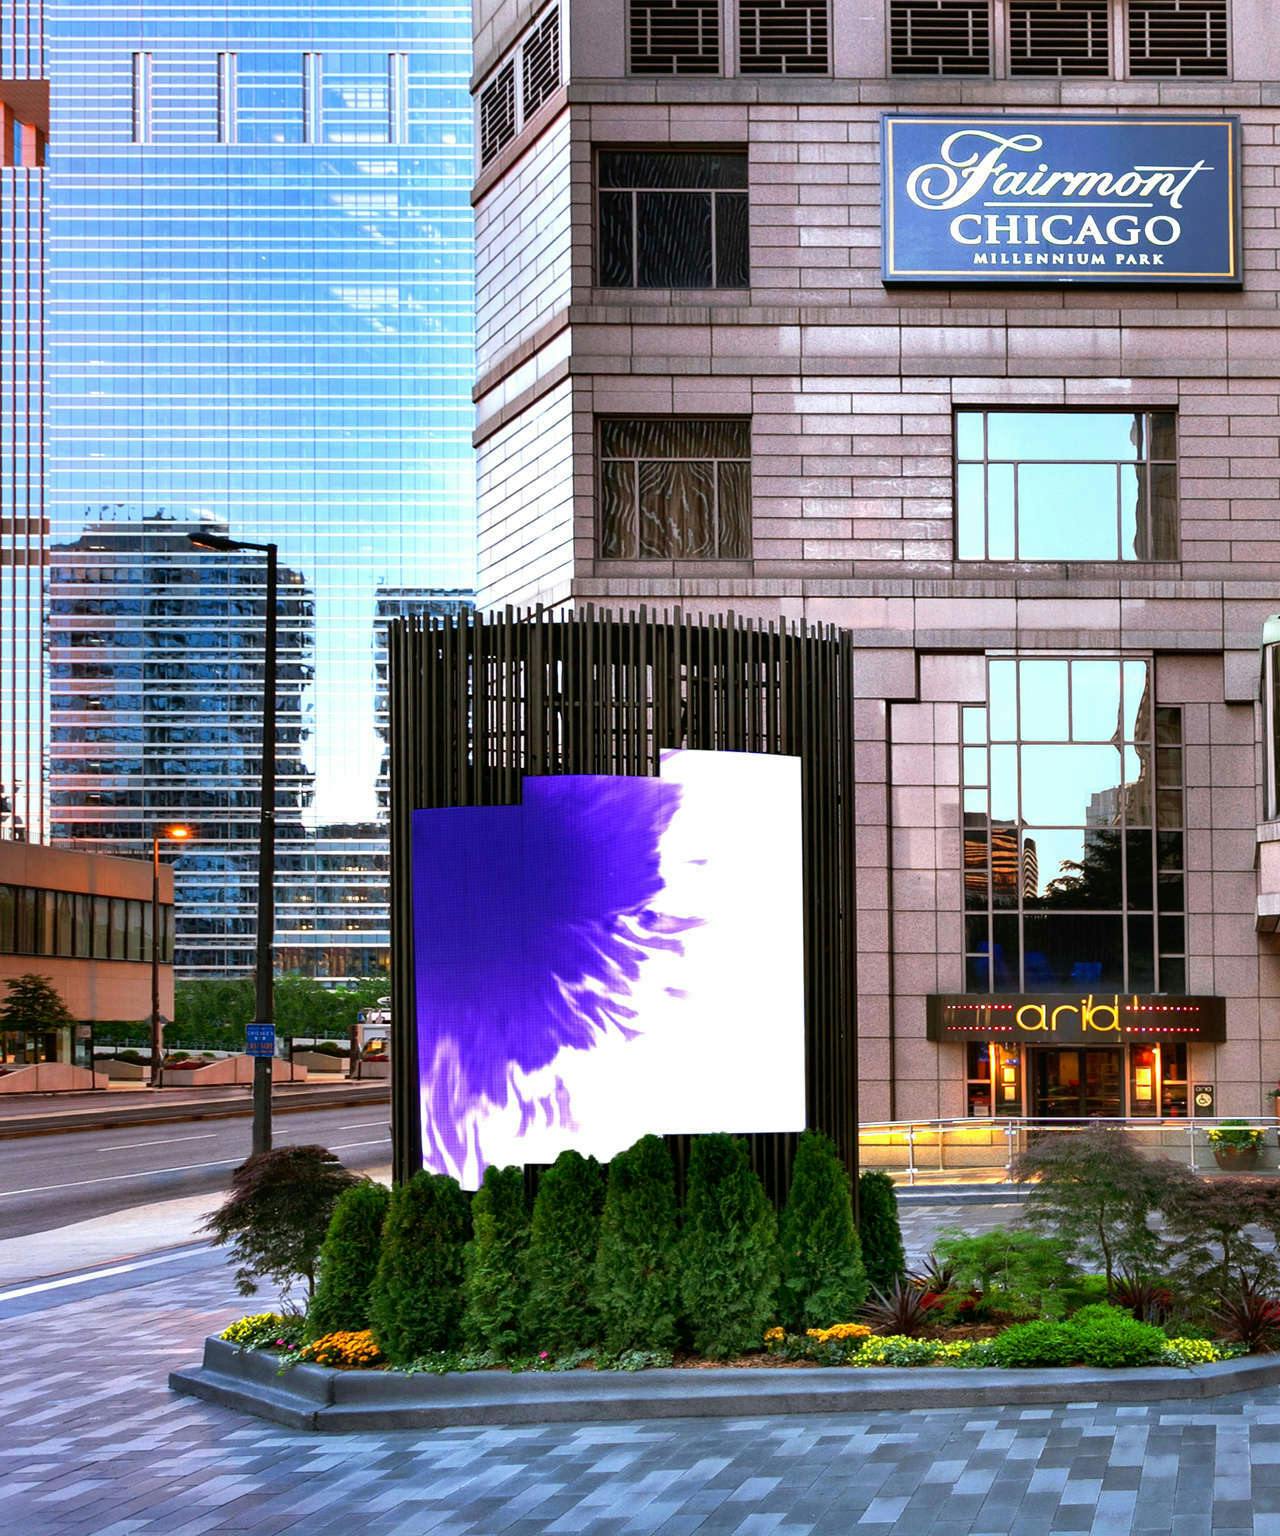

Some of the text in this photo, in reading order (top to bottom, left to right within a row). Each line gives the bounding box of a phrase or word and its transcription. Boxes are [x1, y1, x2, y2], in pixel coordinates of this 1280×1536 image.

[906, 129, 1214, 209] Fairmont
[950, 214, 1181, 246] CHICAGO
[973, 252, 1164, 266] MILLENNIUM PARK
